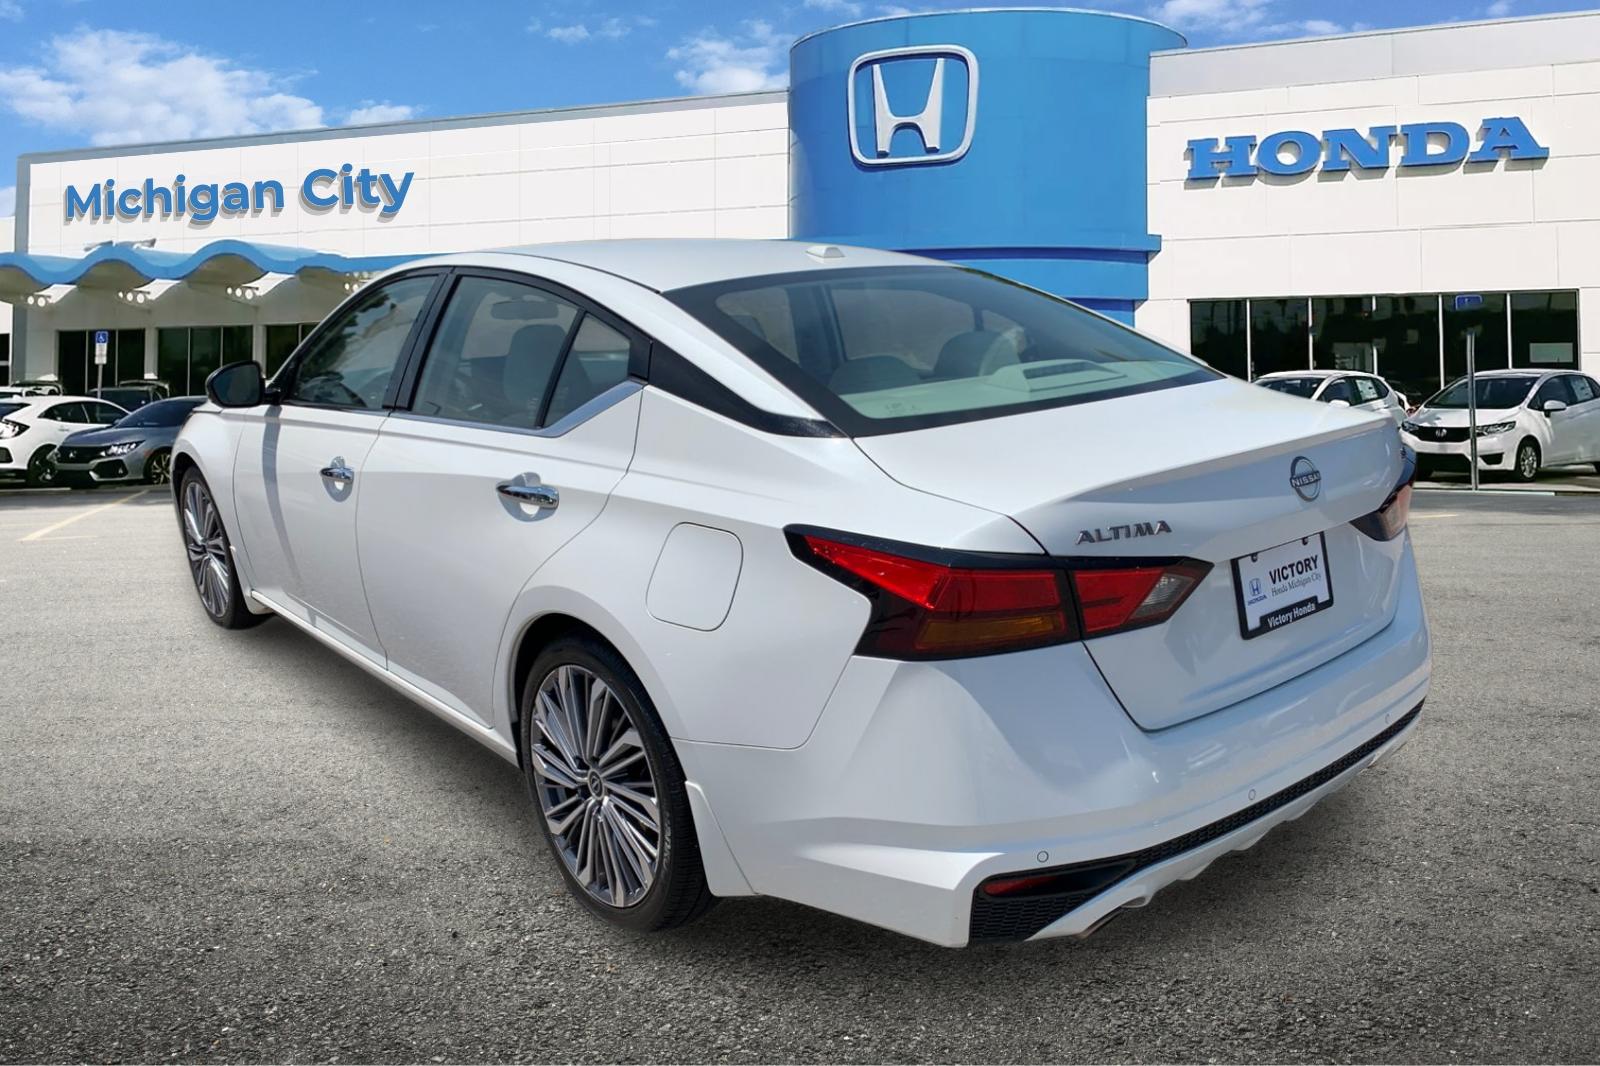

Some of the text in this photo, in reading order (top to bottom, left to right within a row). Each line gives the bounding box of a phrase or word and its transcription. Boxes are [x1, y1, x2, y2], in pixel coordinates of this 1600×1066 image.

[1185, 117, 1550, 183] HONDA
[64, 163, 415, 224] Michigan City
[1075, 520, 1172, 545] ALTIMA
[1269, 555, 1318, 585] VICTORY
[1267, 602, 1316, 628] Victory Honda
